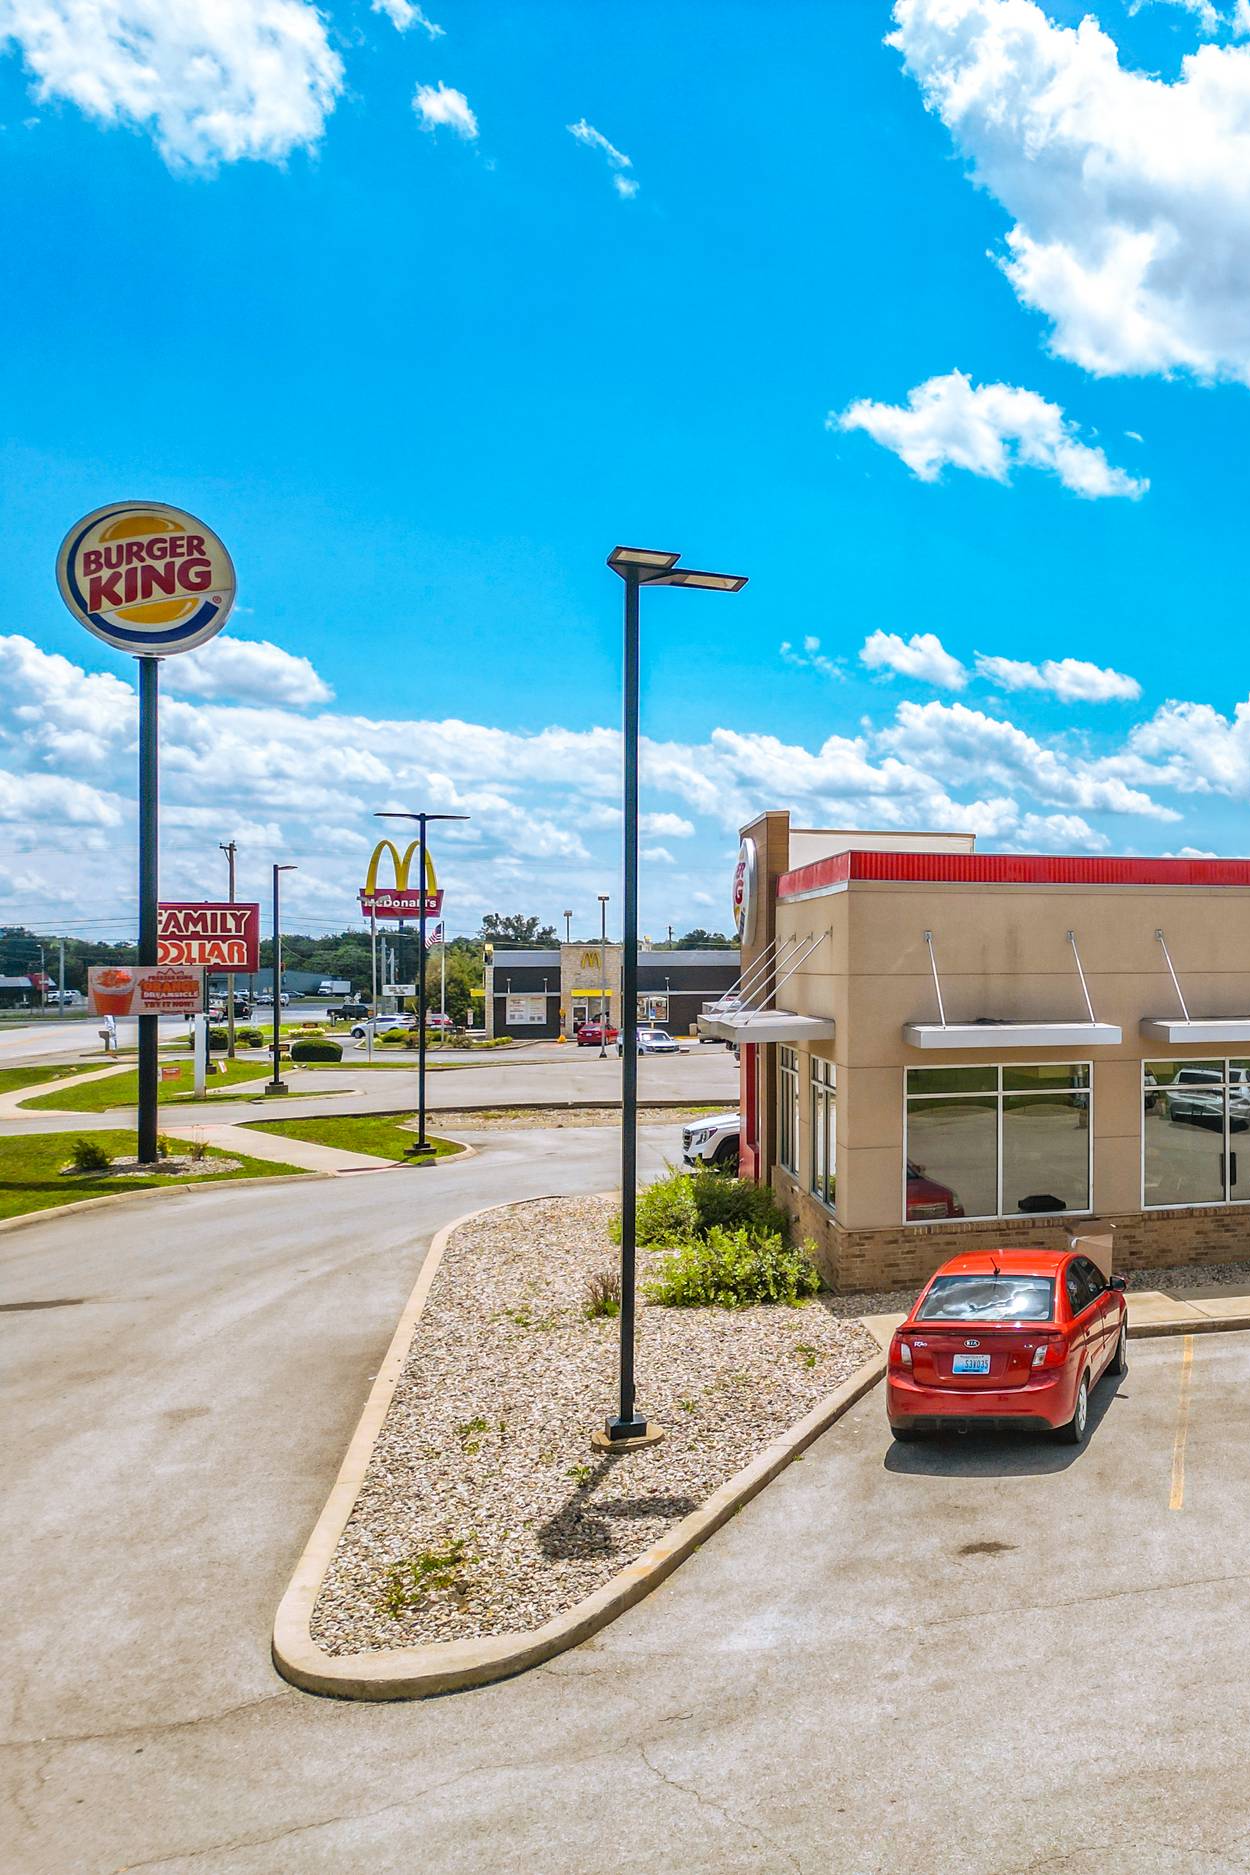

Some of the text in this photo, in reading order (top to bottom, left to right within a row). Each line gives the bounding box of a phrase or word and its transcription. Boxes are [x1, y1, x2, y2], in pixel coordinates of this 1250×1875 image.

[83, 535, 206, 577] BURGER
[88, 557, 212, 612] KING
[142, 981, 198, 992] ORANGE
